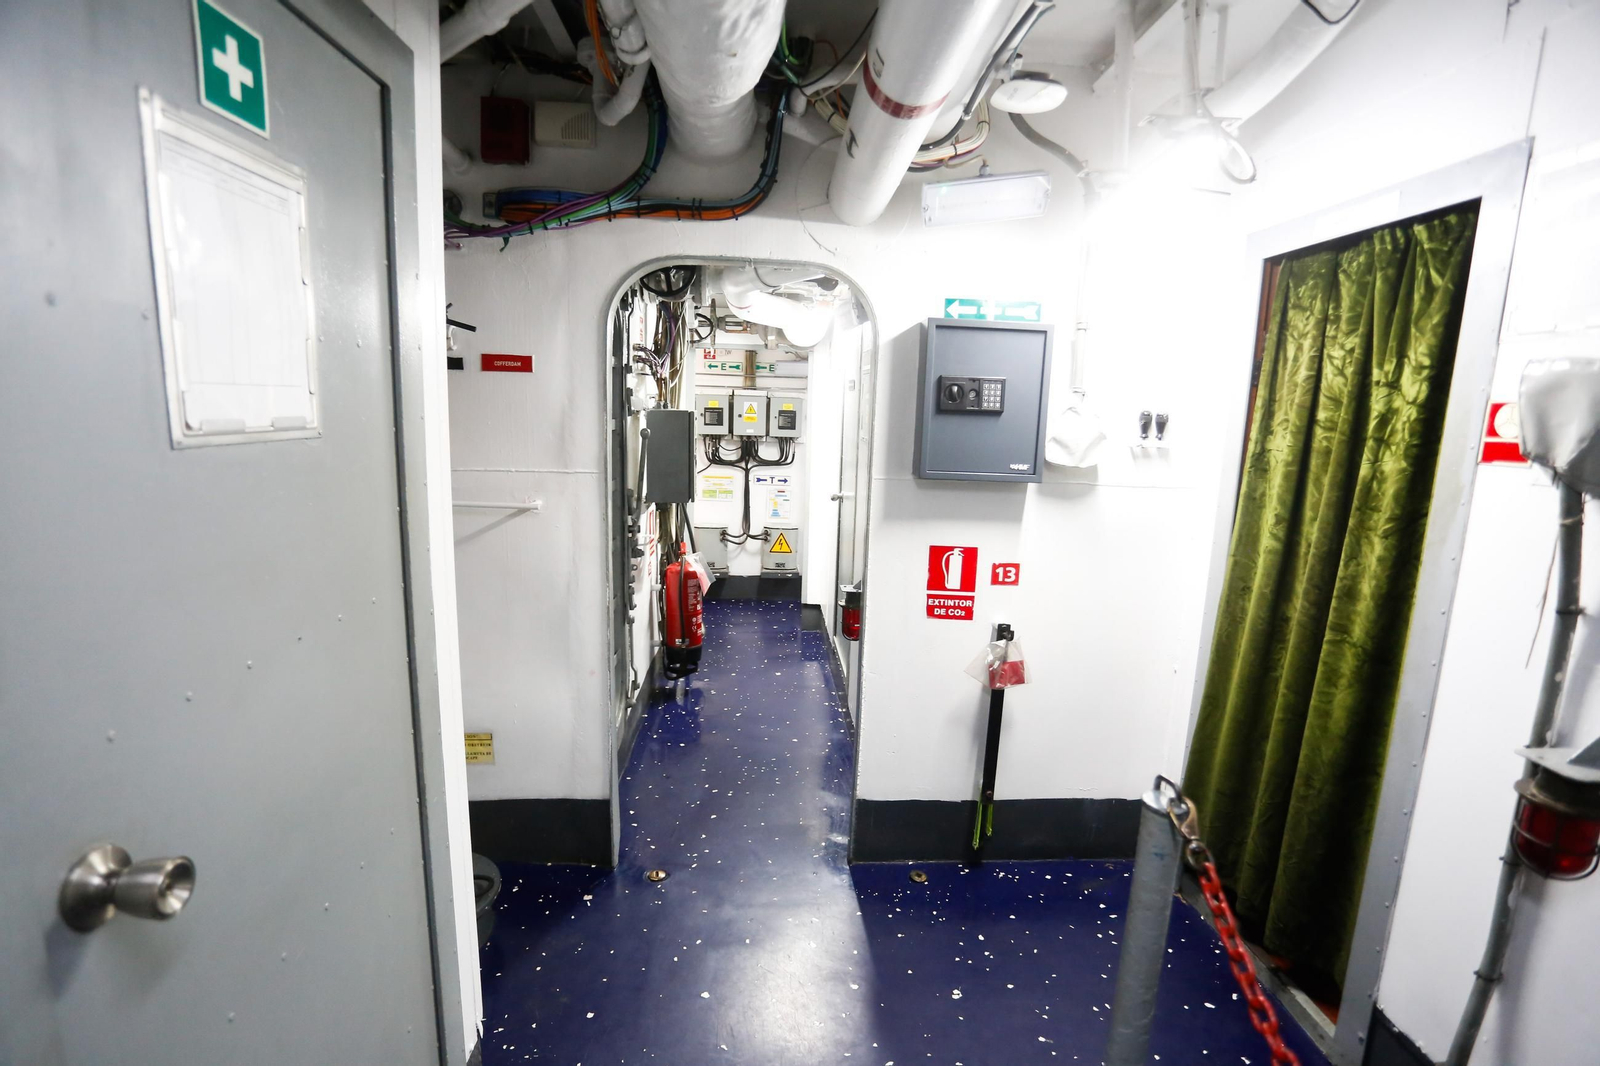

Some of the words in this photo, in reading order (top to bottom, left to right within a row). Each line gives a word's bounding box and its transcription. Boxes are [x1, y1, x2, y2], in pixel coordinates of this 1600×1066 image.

[721, 363, 727, 371] E
[769, 364, 775, 372] E
[769, 476, 776, 484] T
[995, 566, 1016, 582] 13
[928, 598, 973, 607] EXTINTOR
[934, 608, 946, 616] DE
